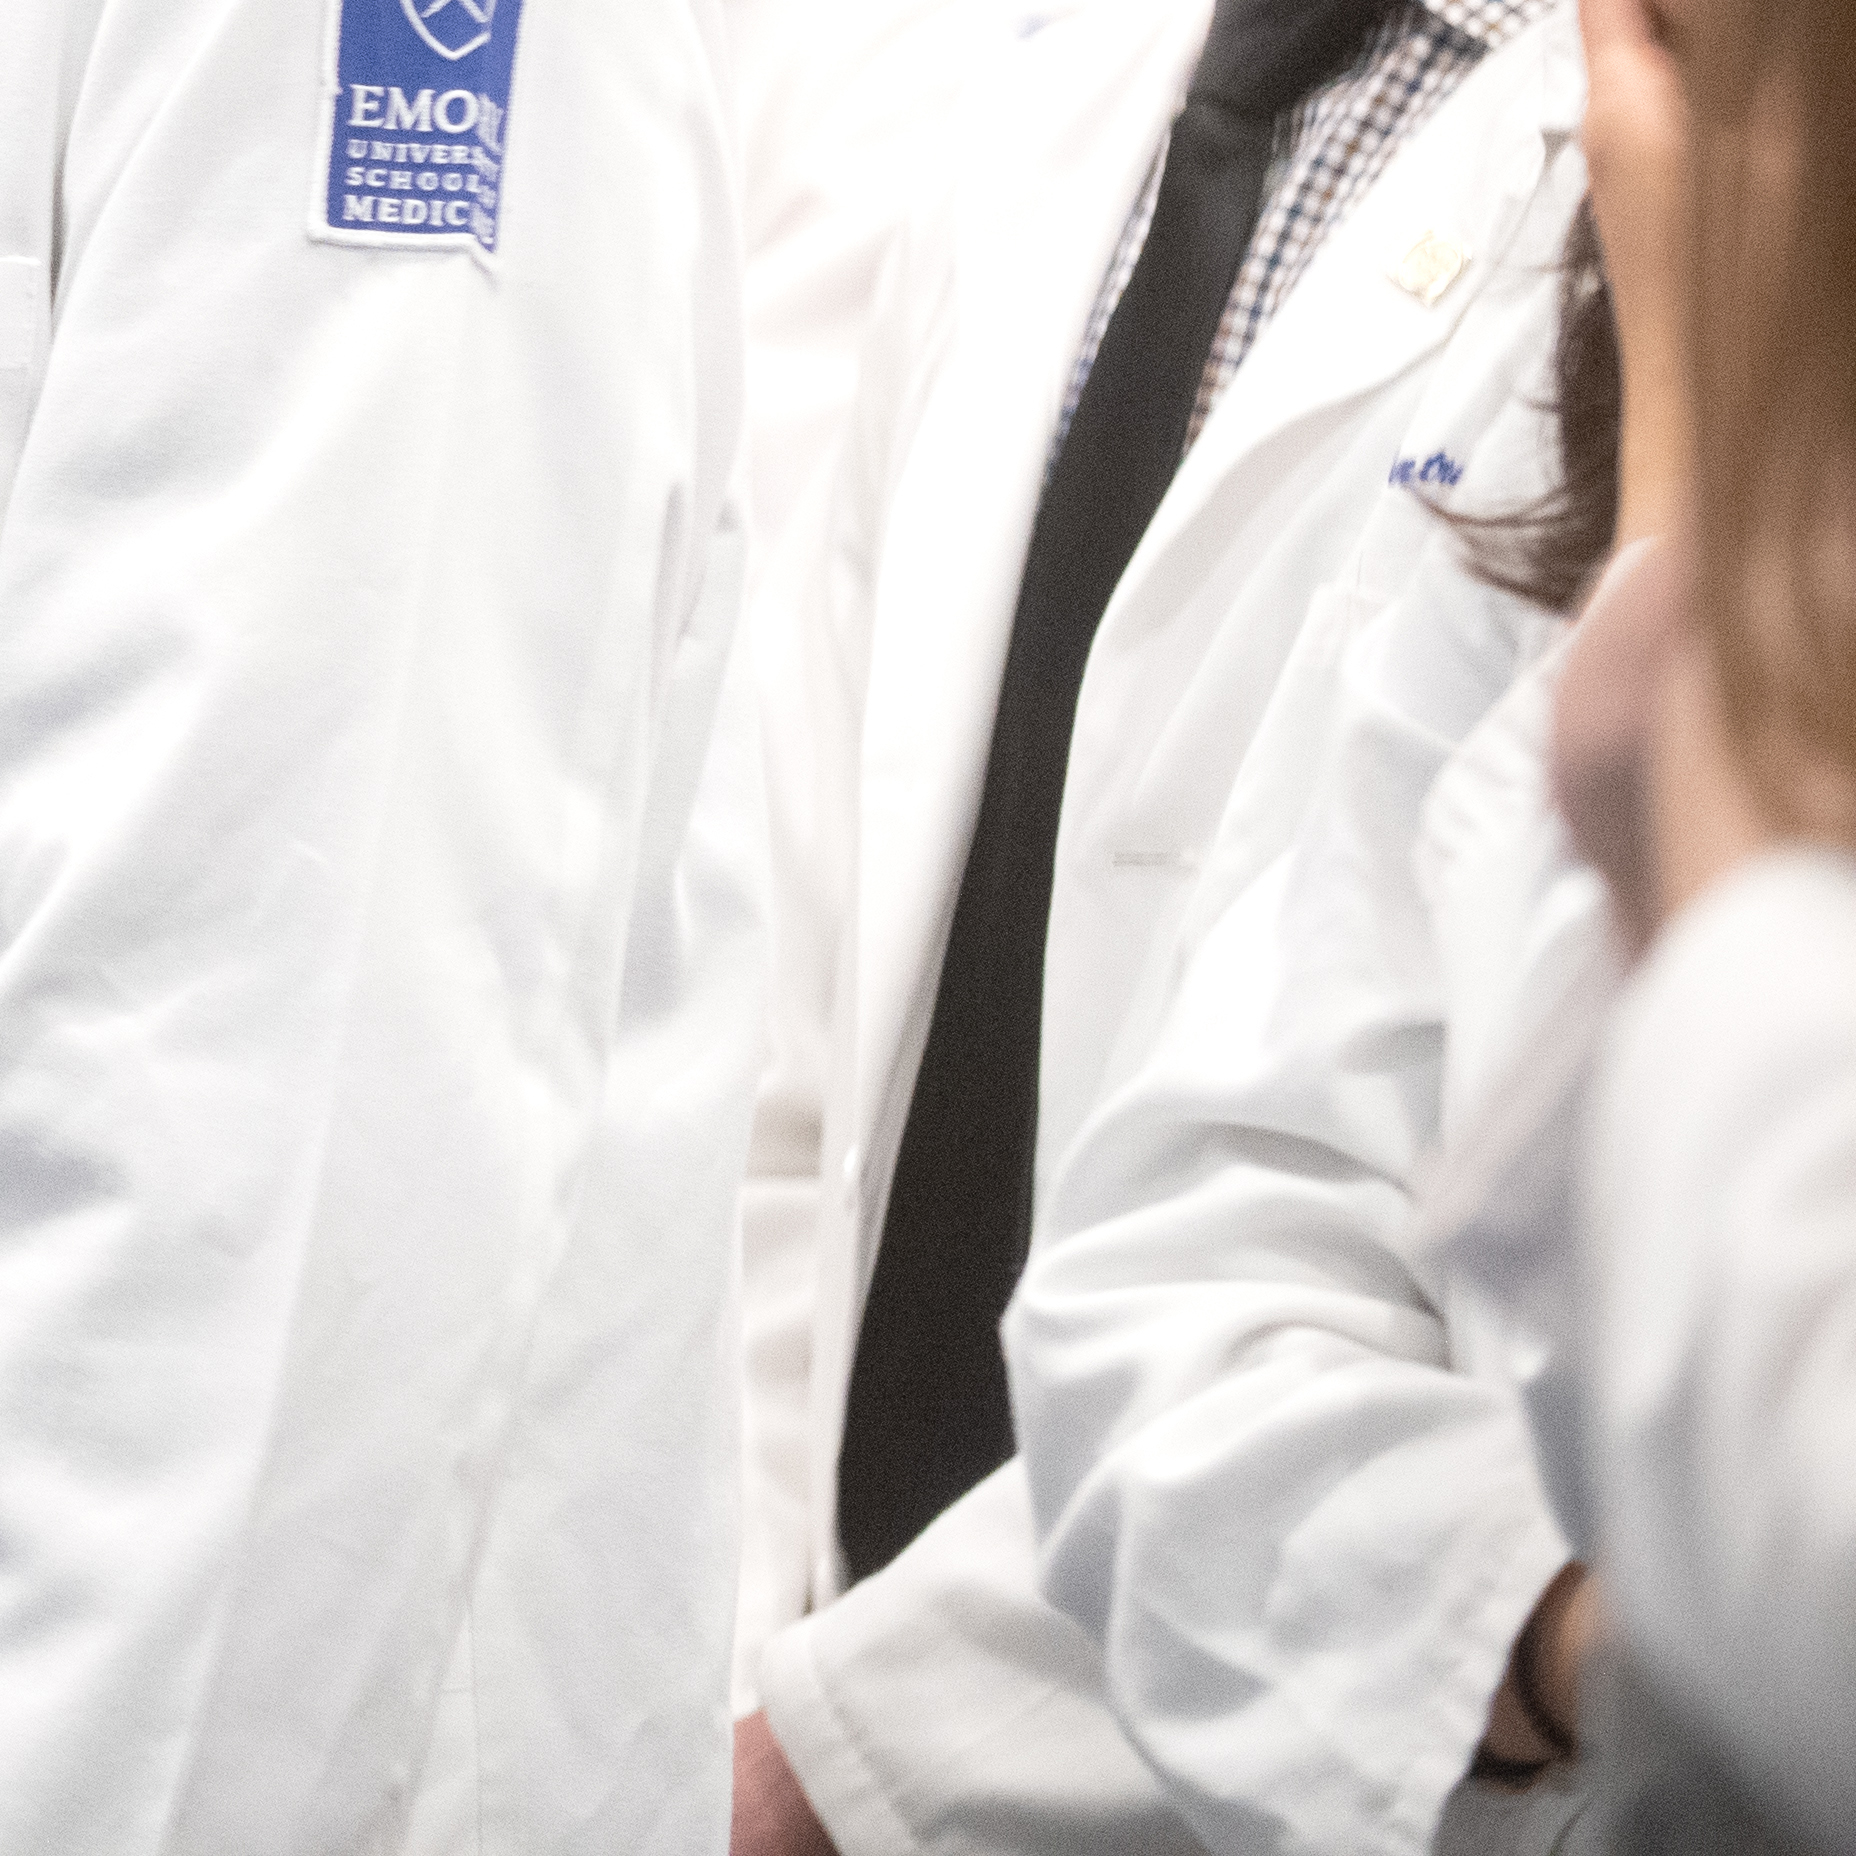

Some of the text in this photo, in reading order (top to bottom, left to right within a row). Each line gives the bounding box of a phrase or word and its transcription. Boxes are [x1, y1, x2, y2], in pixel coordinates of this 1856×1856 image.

[347, 83, 501, 143] EMO
[344, 166, 483, 193] SCHOOL
[342, 193, 494, 230] MEDIC
